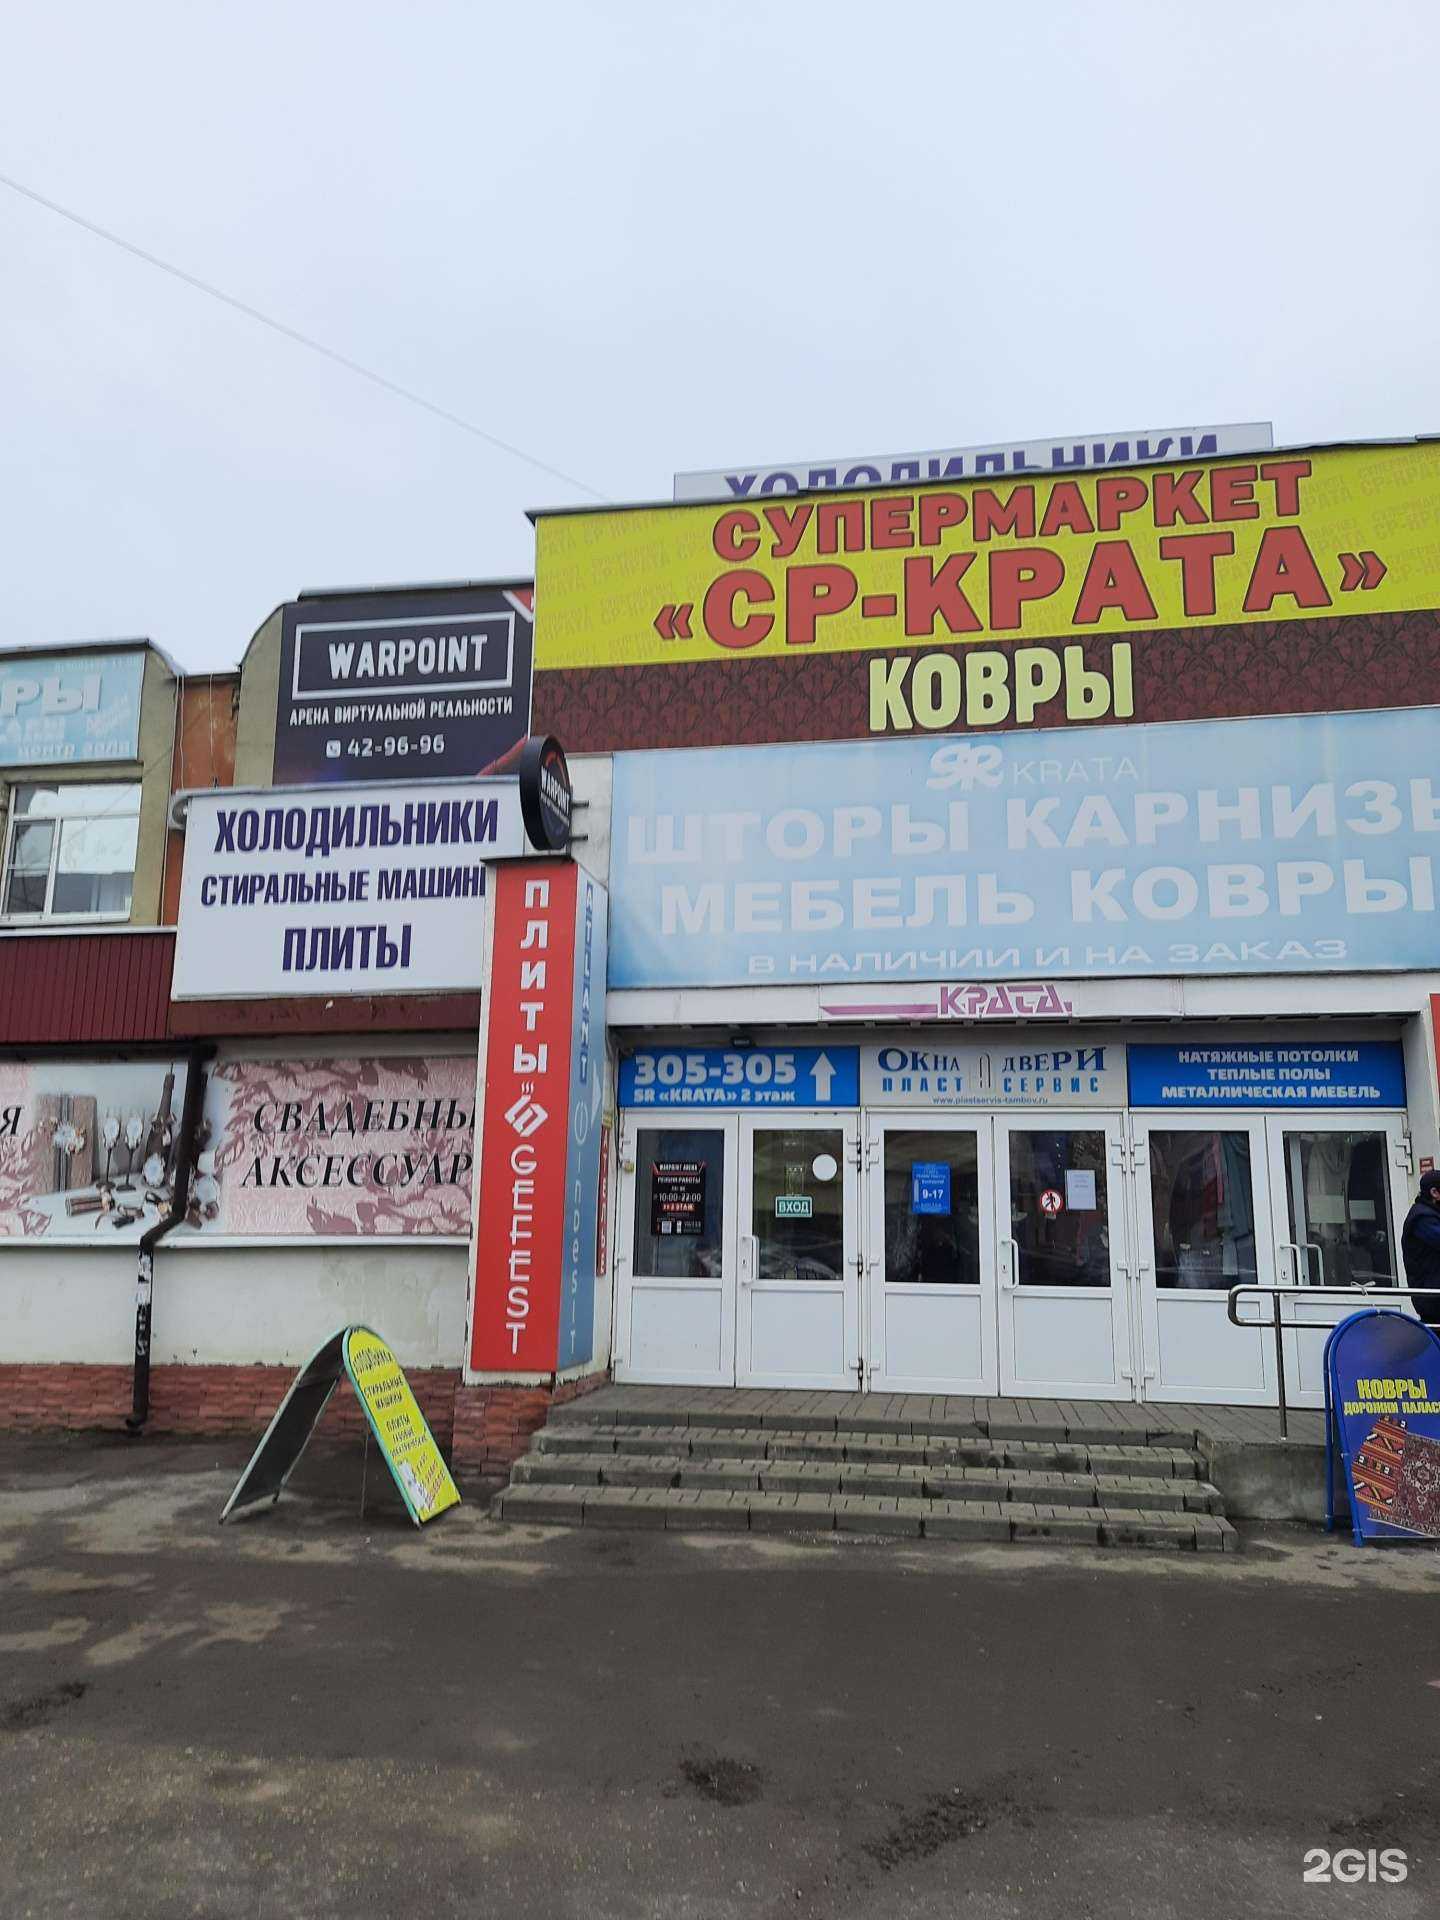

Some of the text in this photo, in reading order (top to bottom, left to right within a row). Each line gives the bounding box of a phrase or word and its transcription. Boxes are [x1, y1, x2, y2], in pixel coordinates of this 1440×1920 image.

[712, 460, 1312, 562] СУПЕРМАРКЕТ
[653, 524, 1388, 649] «СР-КРАТА»
[328, 634, 488, 680] WARPOINT
[868, 642, 1134, 733] КОВРЫ
[289, 696, 512, 726] АРЕНА ВИРТУАЛЬНОЙ РЕАЛЬНОСТИ
[347, 734, 445, 758] 42-96-96
[1012, 756, 1139, 785] KRATA
[540, 765, 570, 817] WARPOINT
[214, 799, 499, 857] ХОЛОДИЛЬНИКИ
[626, 801, 969, 865] ШТОРЫ
[201, 870, 370, 906] СТИРАЛЬНЫЕ
[660, 856, 1435, 936] МЕБЕЛЬ КОВРЫ
[282, 924, 412, 971] ПЛИТЫ
[748, 940, 1348, 976] В НАЛИЧИИ И НА ЗАКАЗ
[513, 879, 549, 1074] ПЛИТЫ
[939, 983, 1073, 1016] КРАТА
[634, 1054, 797, 1086] 305-305
[1002, 1047, 1107, 1072] ДВЕРИ
[1178, 1049, 1359, 1063] НАТЯЖНЫЕ ПОТОЛКИ
[882, 1077, 1099, 1093] ПЛАСТ СЕРВИС
[1207, 1068, 1331, 1081] ТЕПЛЫЕ ПОЛЫ
[633, 1088, 656, 1104] SR
[741, 1088, 751, 1103] 2
[754, 1089, 796, 1103] этаж
[1161, 1085, 1381, 1098] МЕТАЛЛИЧЕСКАЯ МЕБЕЛЬ
[778, 1200, 809, 1214] ВХОД
[506, 1144, 538, 1355] GEFEST
[1356, 1378, 1428, 1400] КОВРЫ
[1343, 1401, 1399, 1415] ДОРОЖКИ
